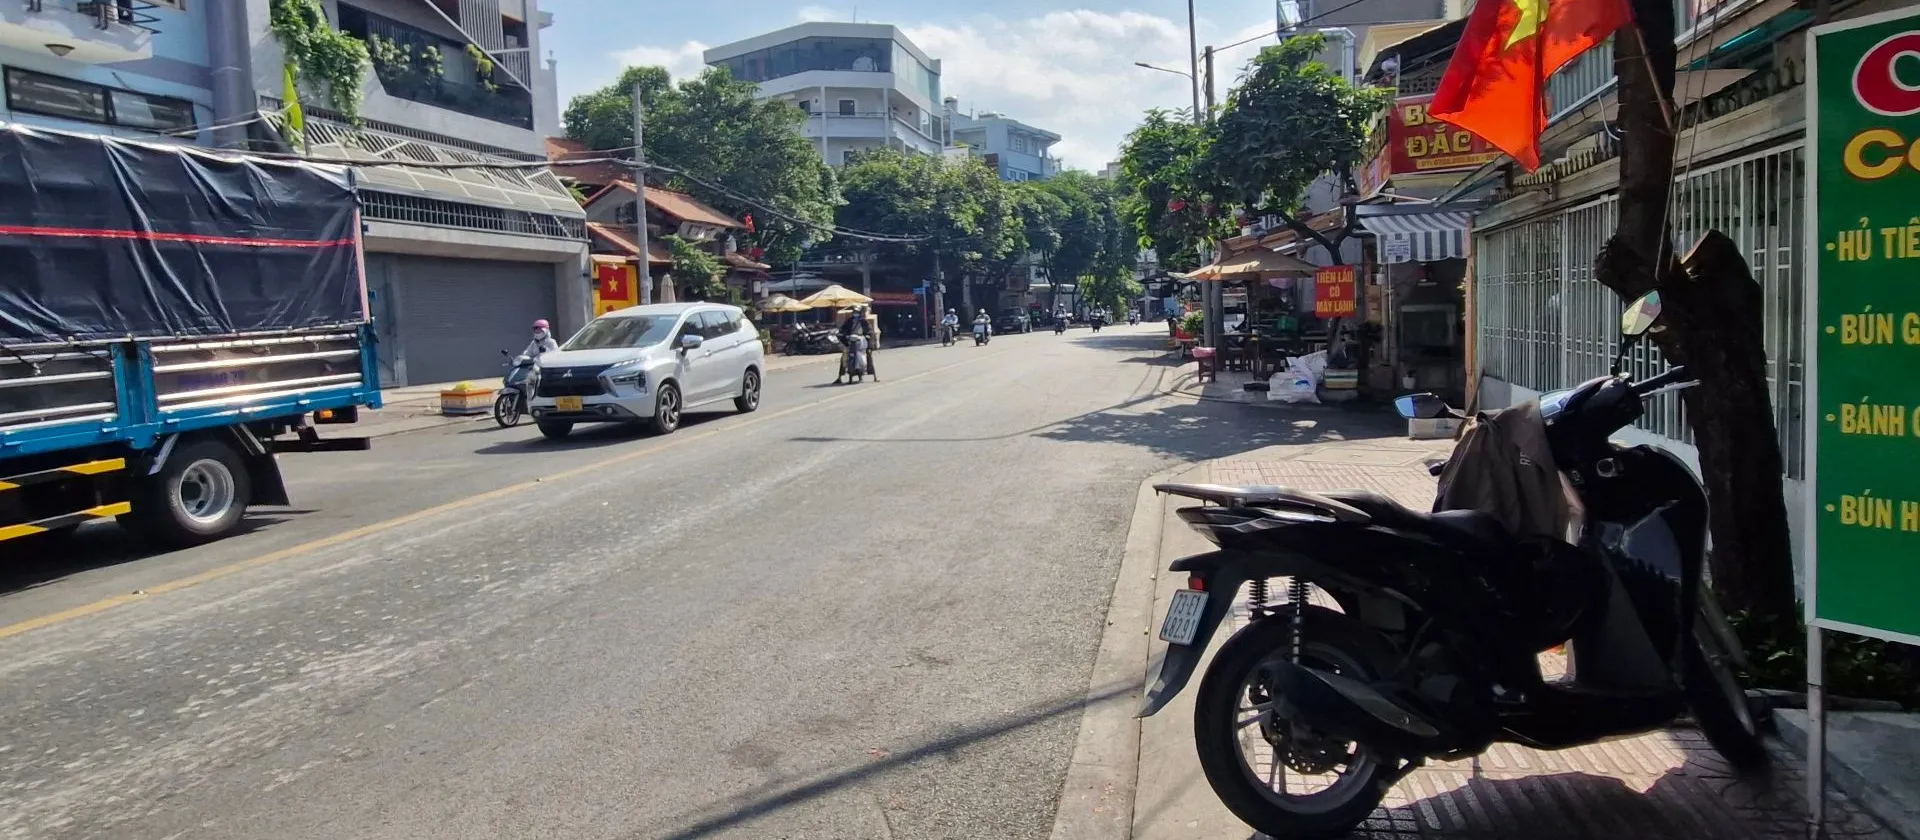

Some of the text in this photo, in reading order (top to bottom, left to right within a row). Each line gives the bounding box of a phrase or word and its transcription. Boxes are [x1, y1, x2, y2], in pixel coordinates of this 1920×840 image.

[1839, 217, 1872, 261] HỦ
[1841, 305, 1894, 344] BÚN
[1841, 396, 1904, 437] BÁNH
[1840, 488, 1892, 529] BÚN
